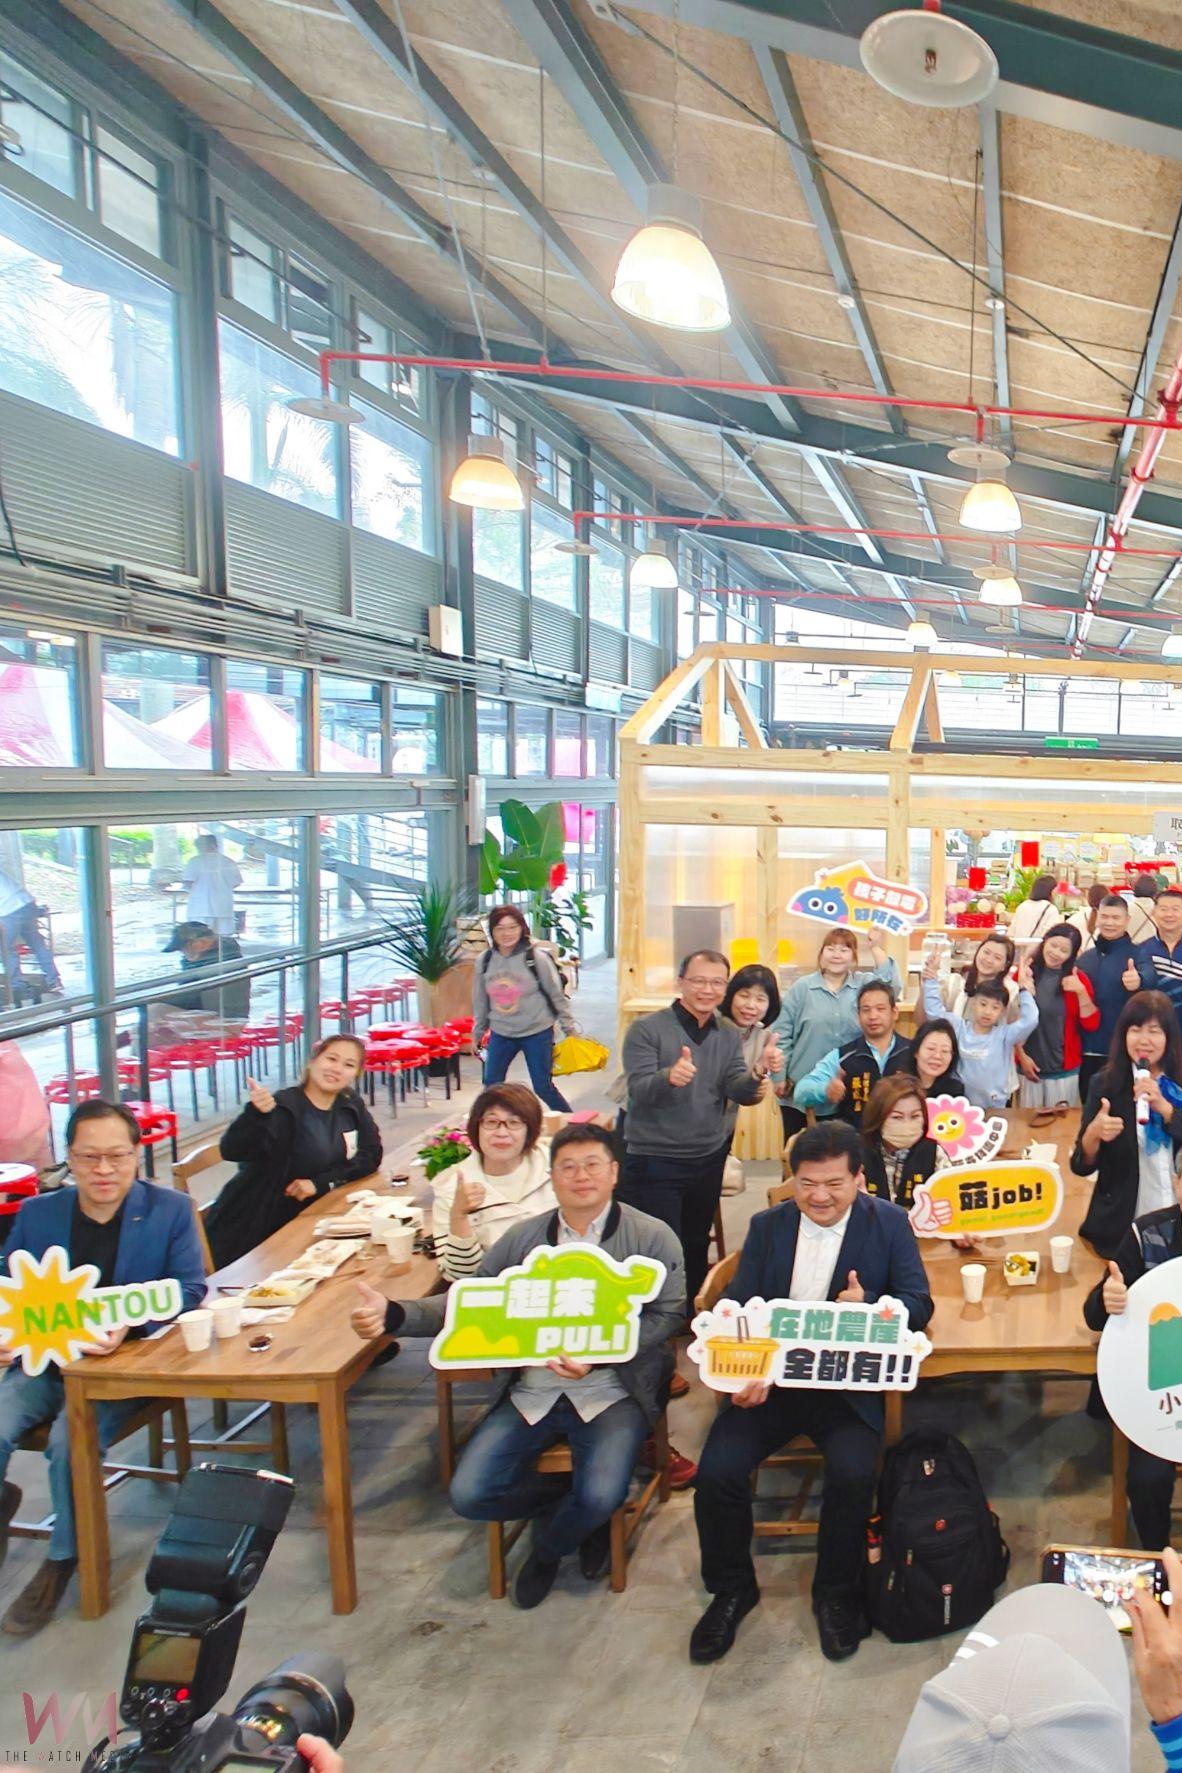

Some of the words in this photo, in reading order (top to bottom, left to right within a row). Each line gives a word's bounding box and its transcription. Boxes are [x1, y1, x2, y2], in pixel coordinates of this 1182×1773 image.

[23, 1286, 173, 1334] NANTOU
[461, 1277, 597, 1319] 一起來
[535, 1324, 627, 1354] PULI
[769, 1306, 901, 1344] 在地農產
[783, 1347, 913, 1384] 全都有!!
